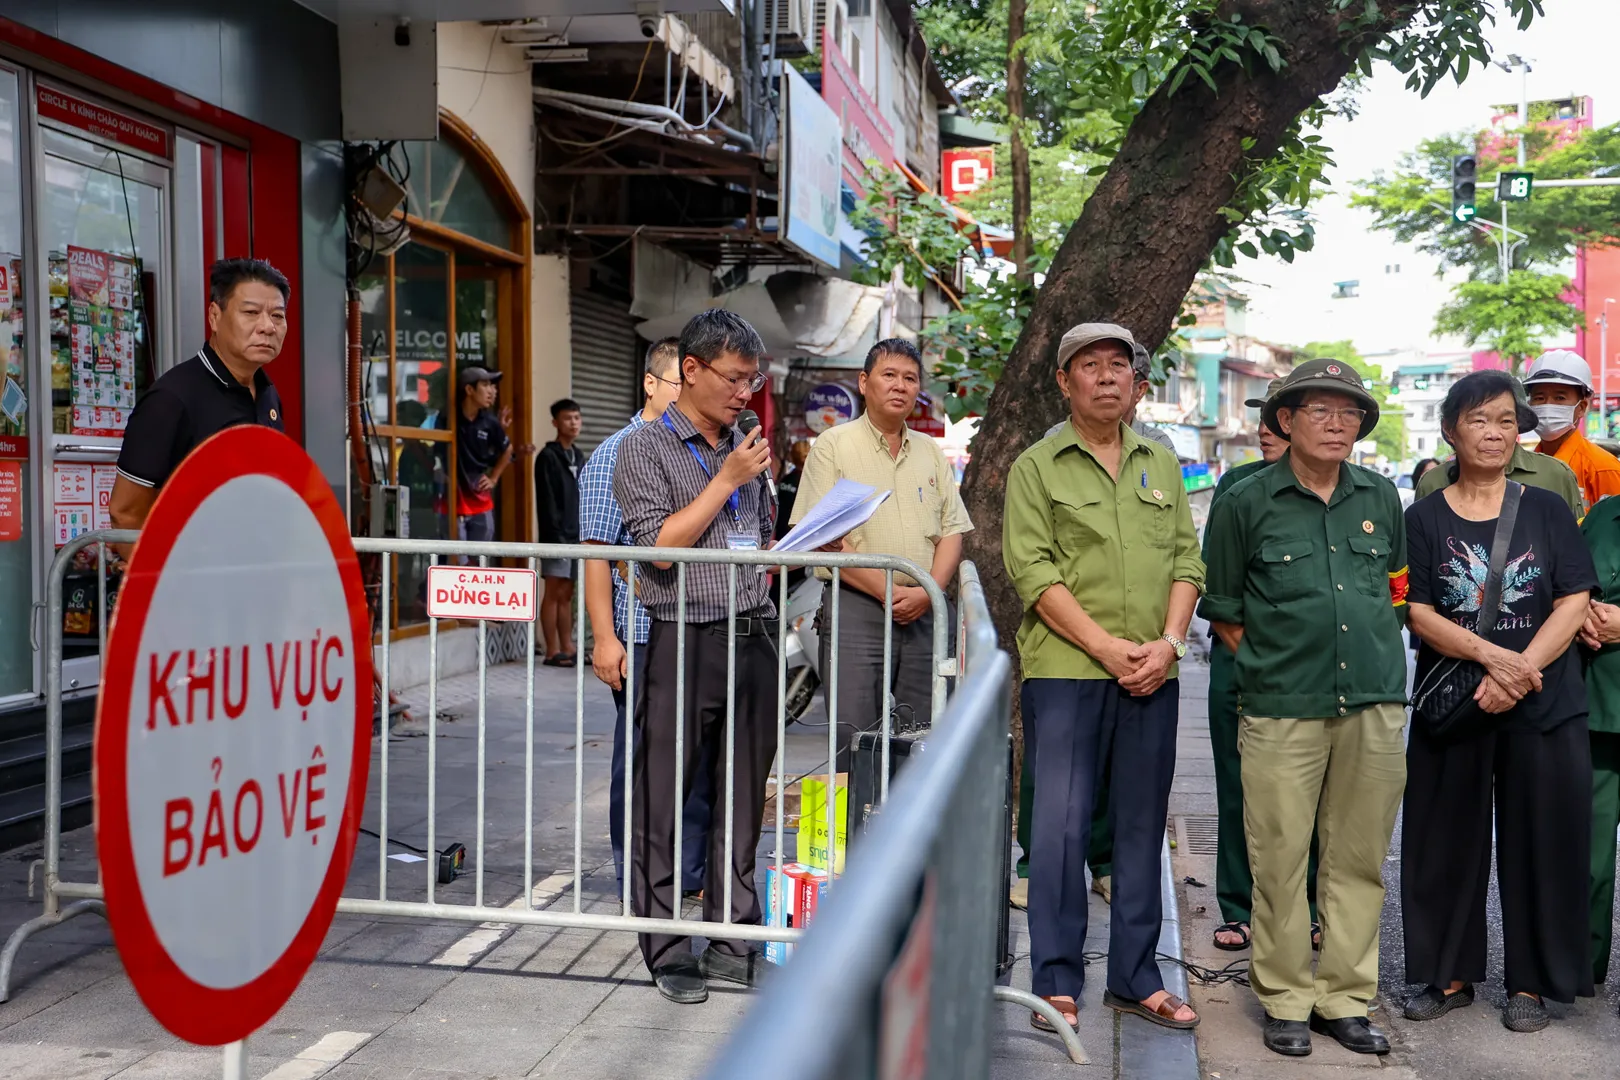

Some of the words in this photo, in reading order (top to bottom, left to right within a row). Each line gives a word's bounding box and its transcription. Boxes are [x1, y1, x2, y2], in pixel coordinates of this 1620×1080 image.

[39, 91, 68, 111] CIRCLE
[71, 103, 77, 114] K
[78, 104, 96, 120] KÍNH
[97, 112, 118, 128] CHÀO
[119, 119, 134, 135] QUÝ
[135, 127, 159, 143] KHÁCH
[1511, 177, 1528, 197] 18
[69, 251, 105, 271] DEALS
[371, 330, 480, 349] WELCOME
[459, 574, 505, 584] C.A.H.N
[436, 584, 490, 605] DỪNG
[495, 592, 527, 610] LẠI
[146, 644, 250, 730] KHU
[265, 628, 344, 722] VỰC
[162, 756, 264, 879] BẢO
[278, 744, 327, 845] VỆ
[809, 846, 829, 863] plus
